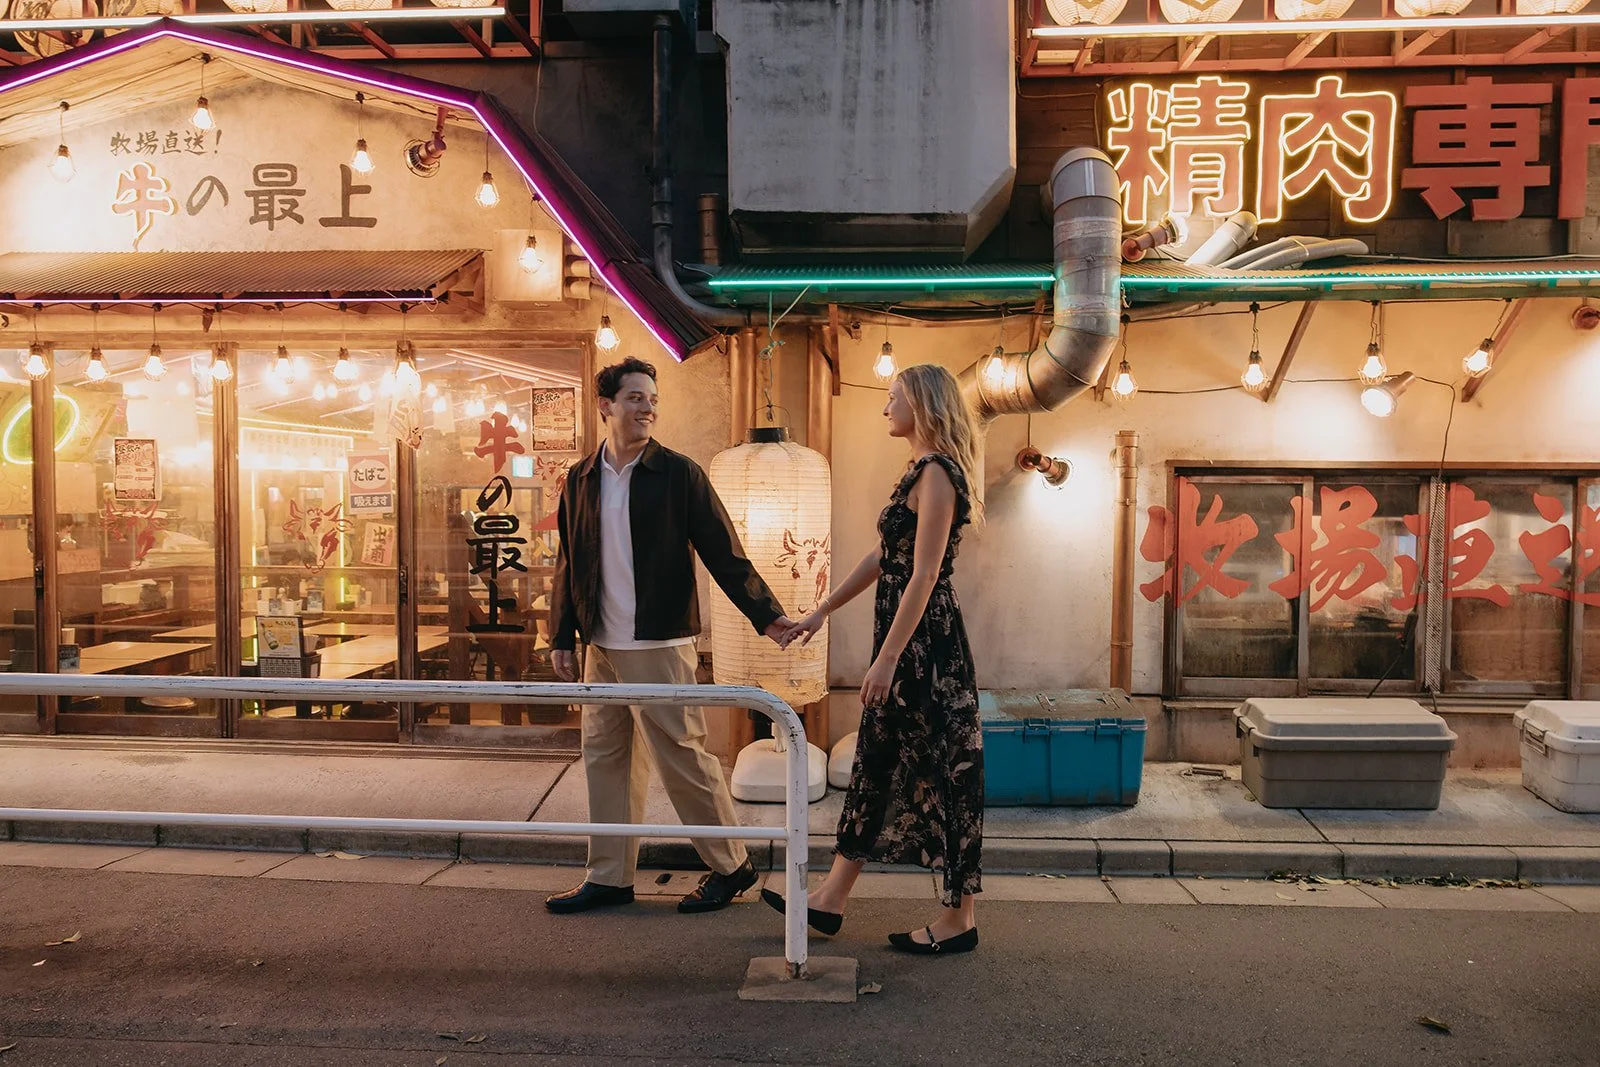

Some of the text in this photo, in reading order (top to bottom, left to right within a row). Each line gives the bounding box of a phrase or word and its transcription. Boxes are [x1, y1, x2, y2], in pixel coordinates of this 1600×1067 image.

[109, 128, 223, 157] 牧場直送!
[1106, 75, 1600, 225] 精肉専
[111, 160, 378, 250] 牛の最上
[353, 467, 387, 482] たばこ
[354, 496, 389, 507] 吸えます
[466, 411, 529, 633] 牛の最上
[371, 526, 388, 564] 出前
